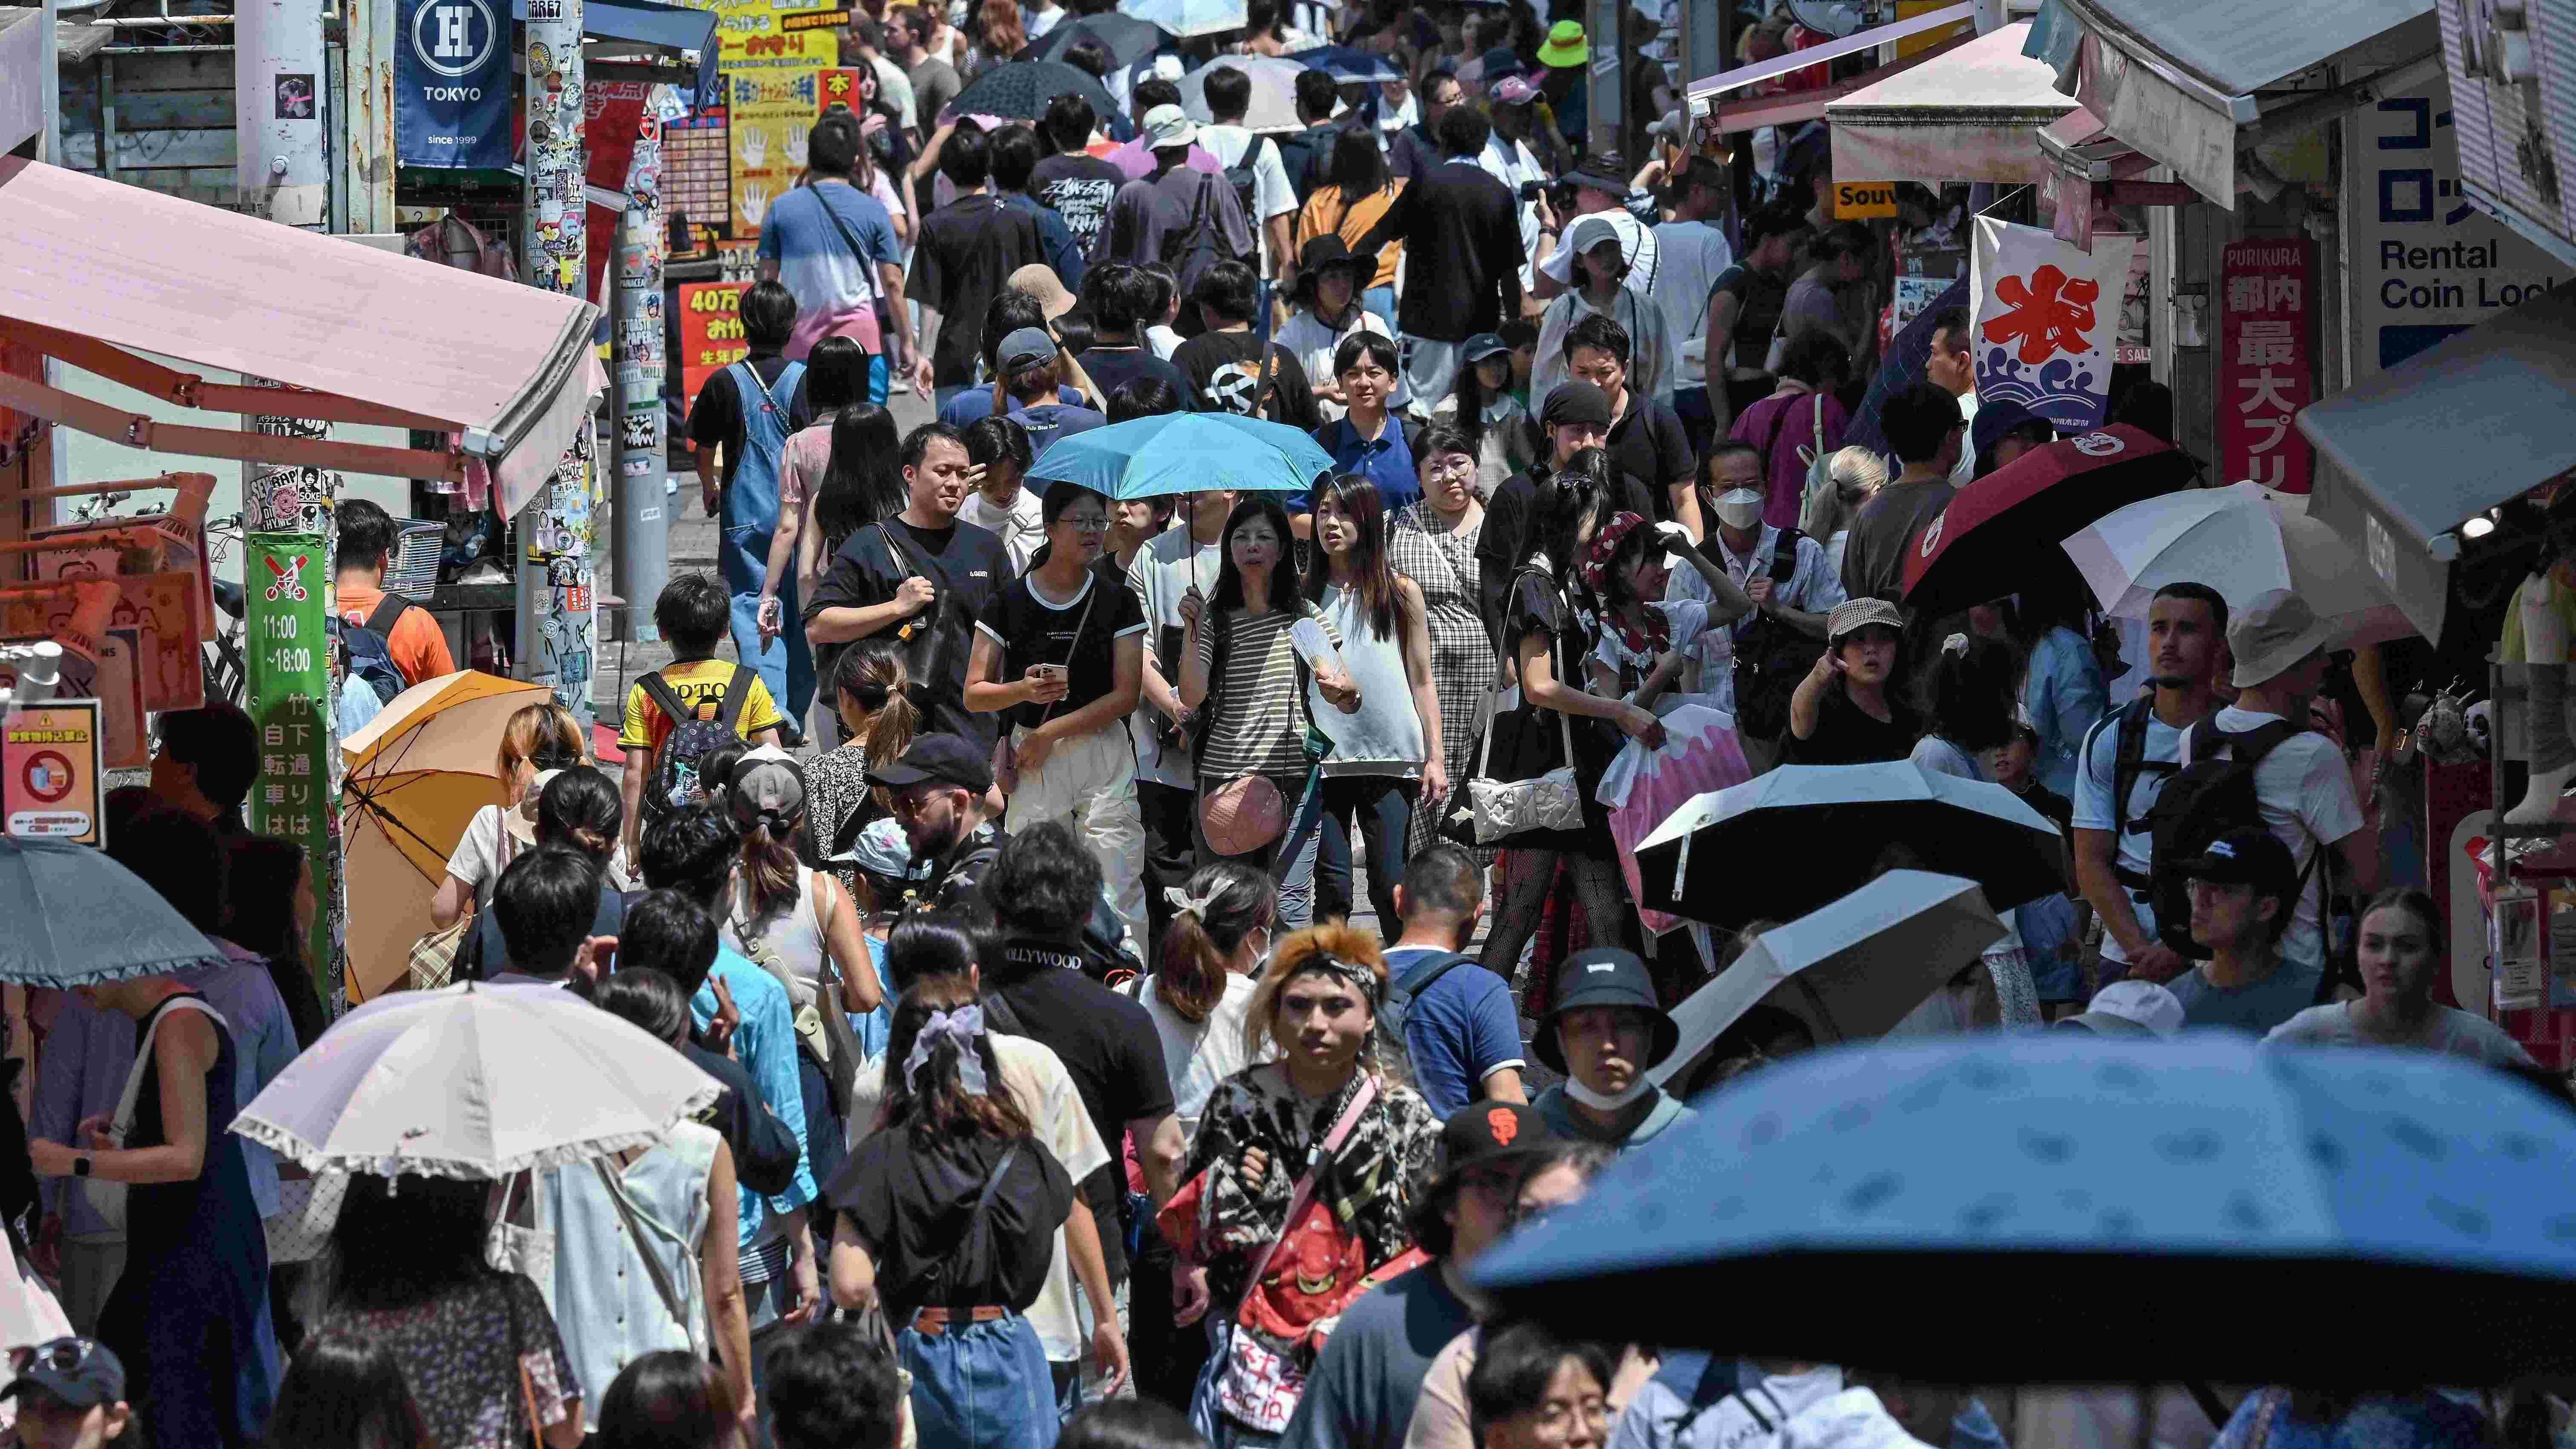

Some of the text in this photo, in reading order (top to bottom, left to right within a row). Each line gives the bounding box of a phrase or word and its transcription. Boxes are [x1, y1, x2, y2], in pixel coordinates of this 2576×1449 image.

[424, 86, 481, 101] TOKYO
[428, 135, 477, 144] since 1999
[2227, 247, 2301, 267] PURIKURA
[2380, 239, 2498, 270] Rental
[690, 289, 740, 313] 40万
[2228, 275, 2302, 312] 都内
[2380, 278, 2464, 309] Coin
[2237, 320, 2297, 490] 最大プリ
[299, 492, 321, 500] SOKE
[263, 614, 297, 638] 11:00
[266, 647, 310, 673] ~18:00
[673, 682, 727, 699] OTO
[263, 723, 286, 836] 自転車は
